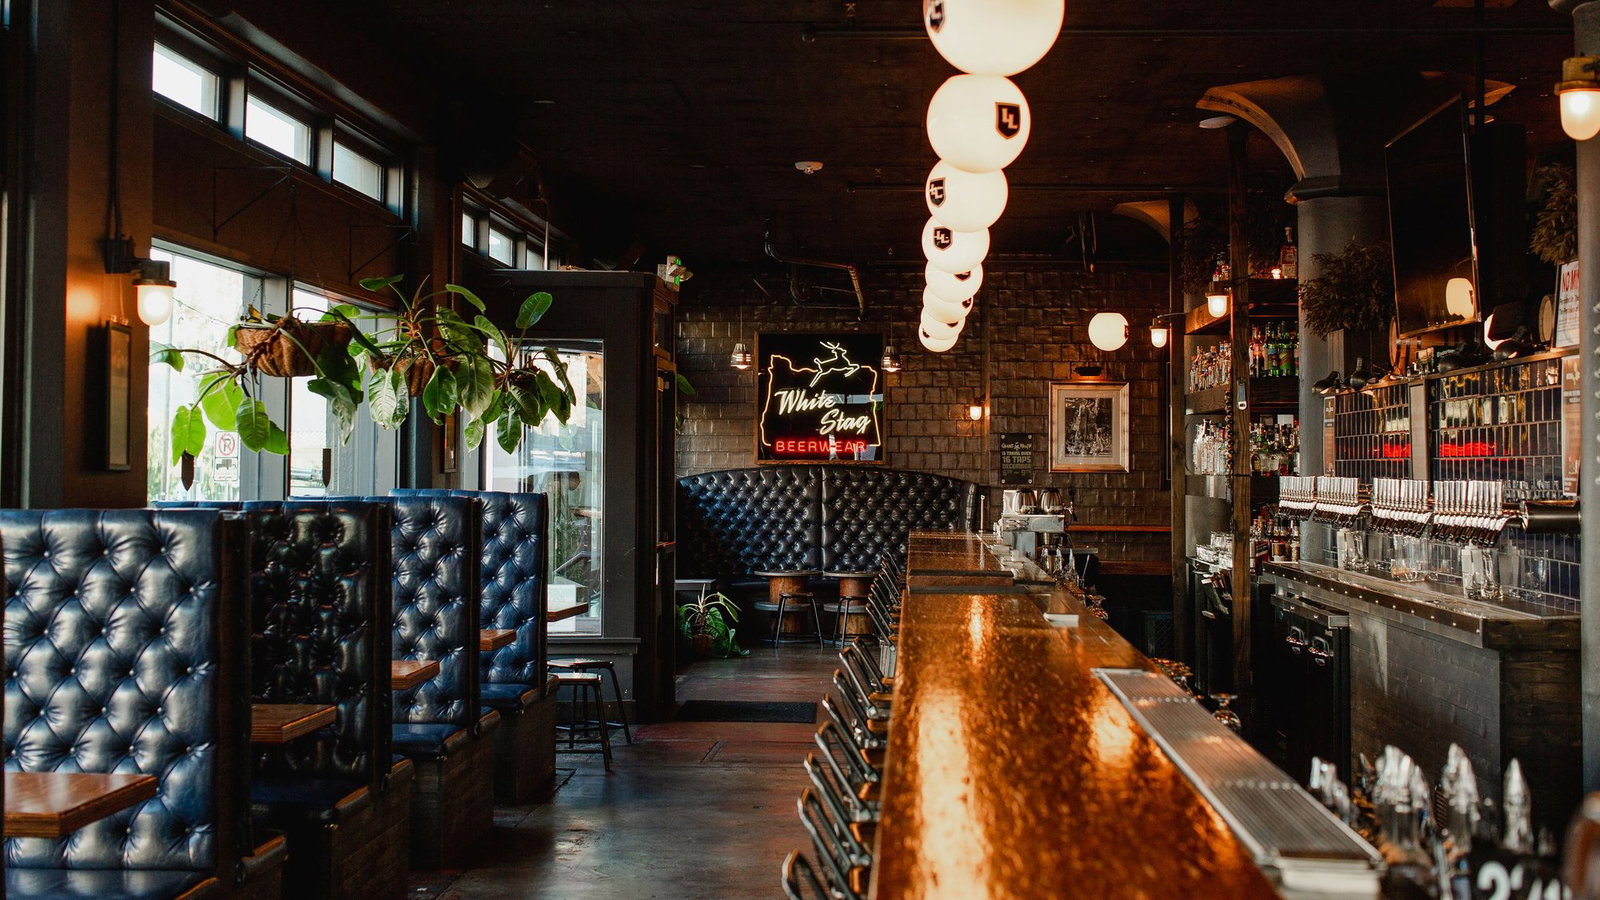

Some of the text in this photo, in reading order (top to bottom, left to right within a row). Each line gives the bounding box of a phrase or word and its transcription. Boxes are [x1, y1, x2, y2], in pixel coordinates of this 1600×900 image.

[774, 388, 836, 415] White
[819, 408, 871, 435] Stag
[775, 440, 866, 452] BEERWEAR
